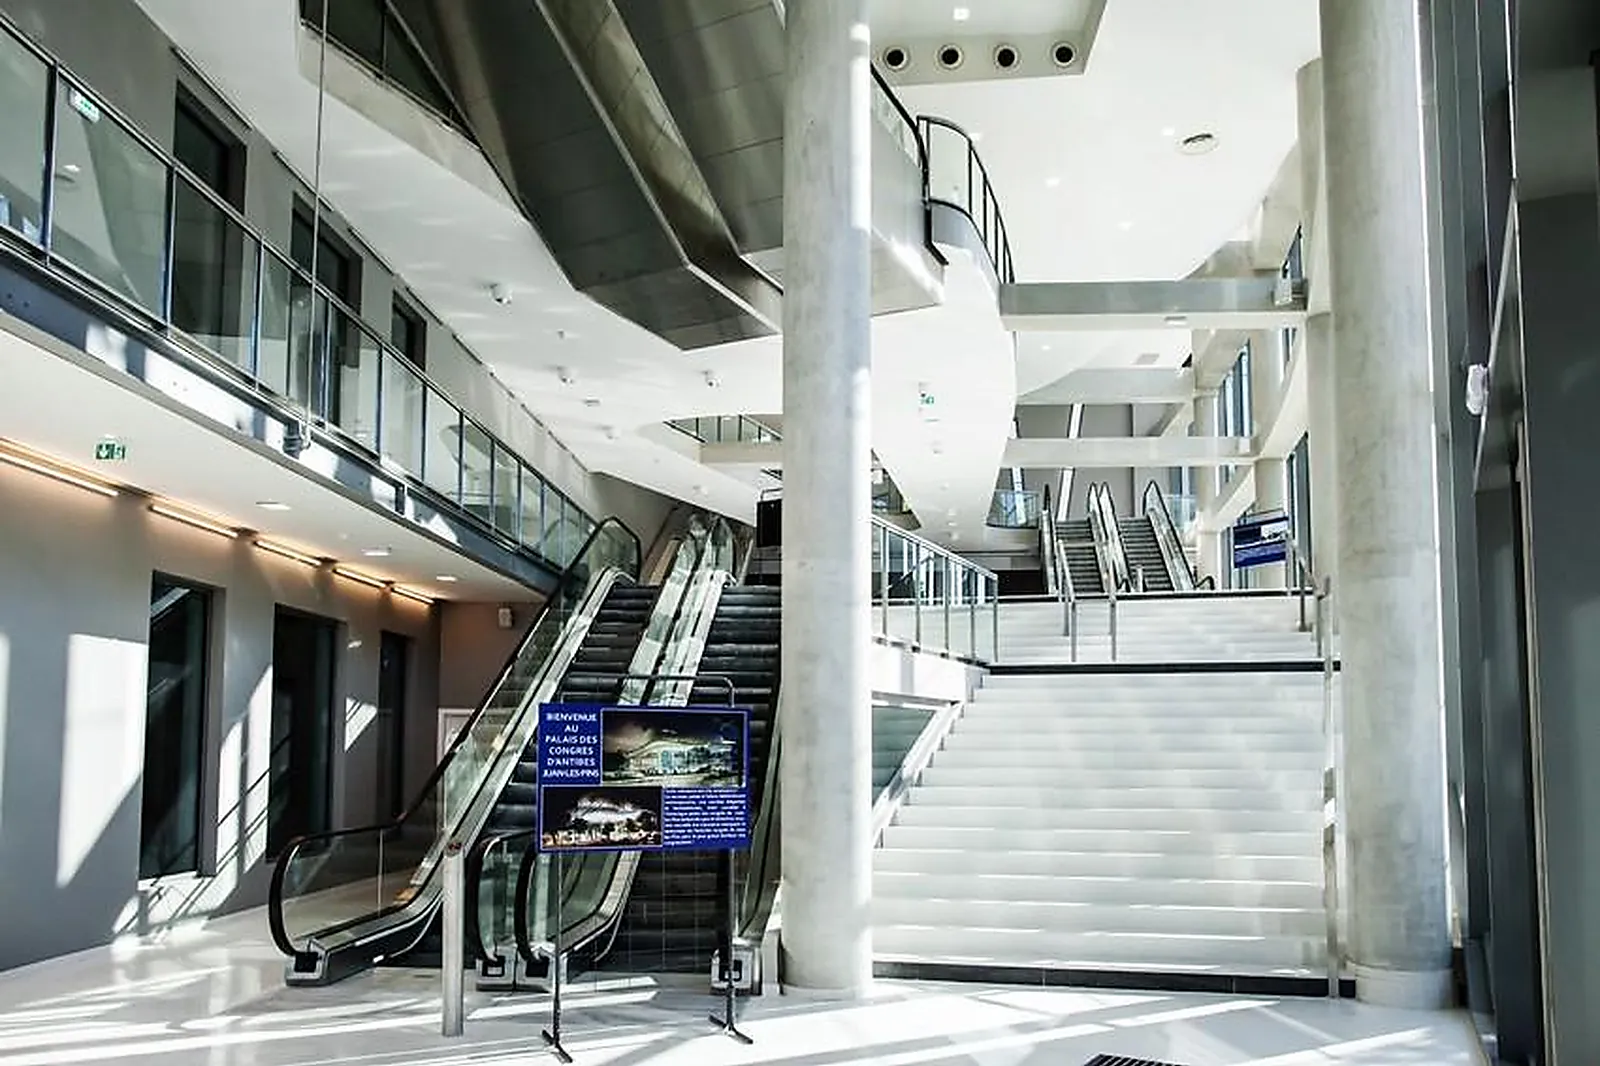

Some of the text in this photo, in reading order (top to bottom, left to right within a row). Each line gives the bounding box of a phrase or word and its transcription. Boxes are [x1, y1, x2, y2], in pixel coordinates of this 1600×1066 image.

[546, 713, 597, 721] BIENVENUE
[564, 724, 578, 733] AU
[545, 735, 597, 744] PALAIS DES
